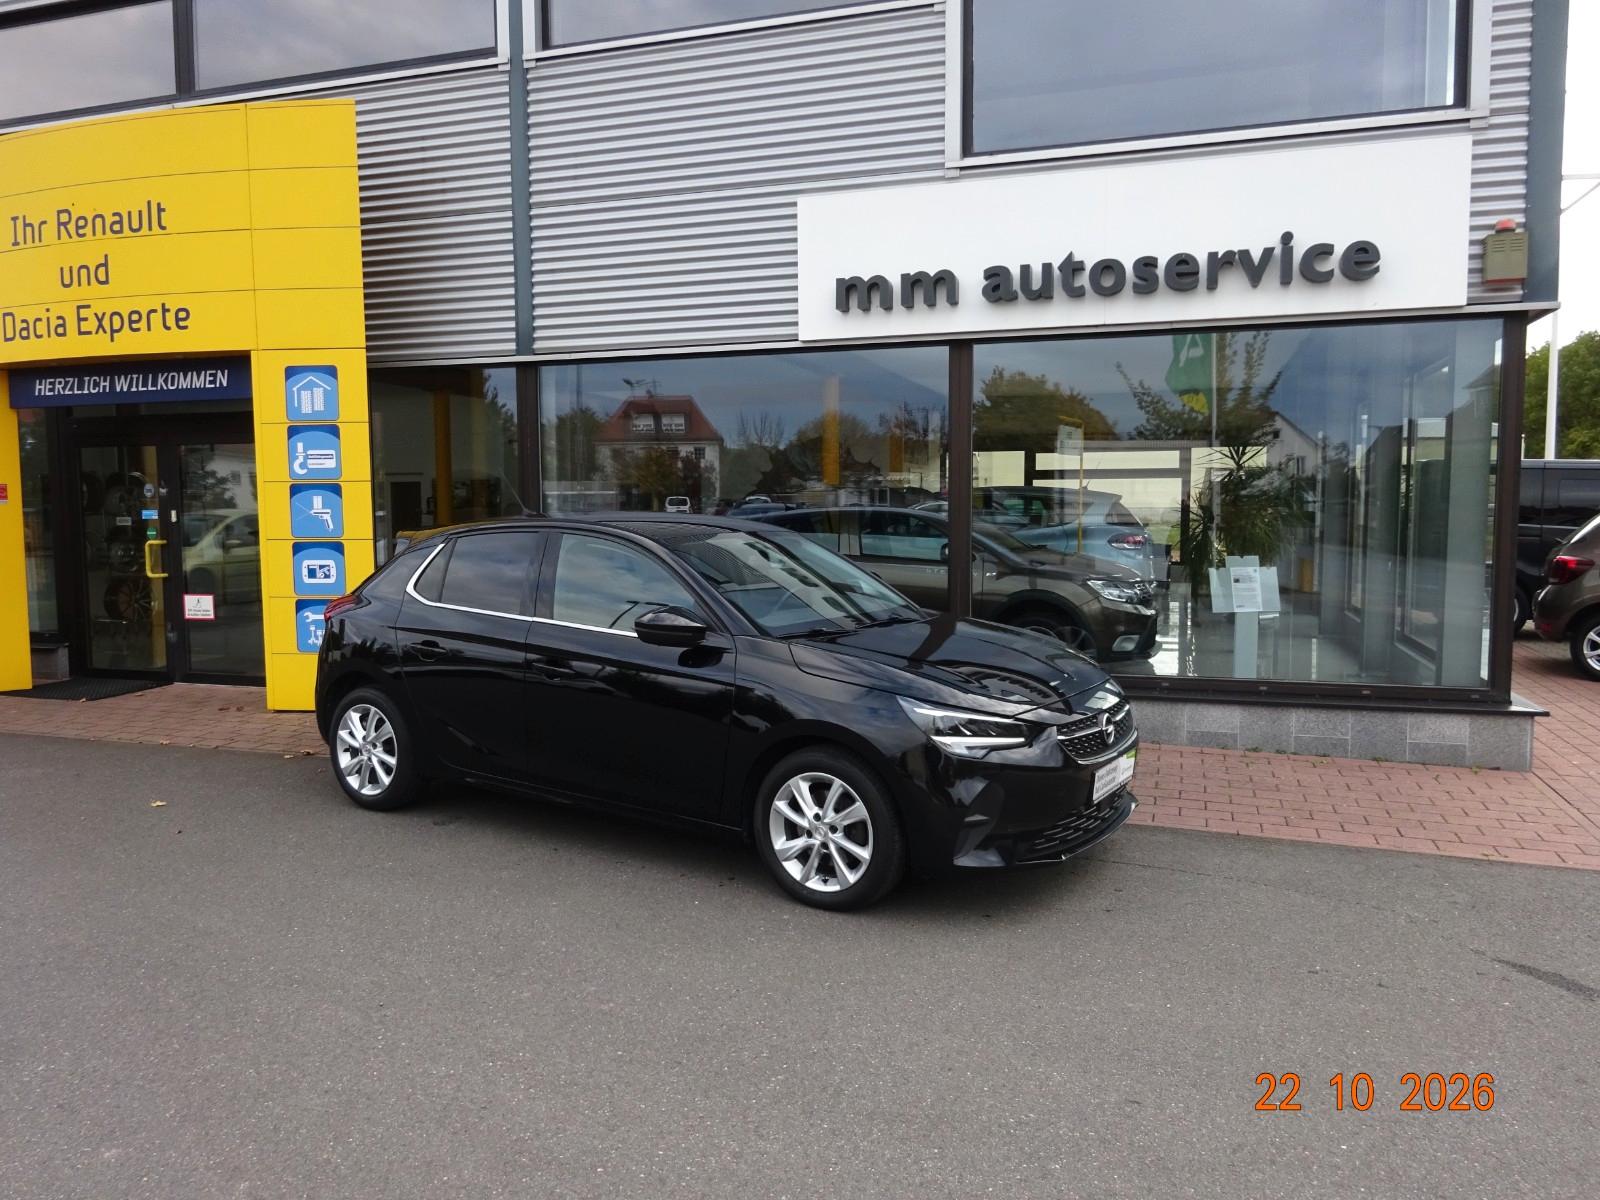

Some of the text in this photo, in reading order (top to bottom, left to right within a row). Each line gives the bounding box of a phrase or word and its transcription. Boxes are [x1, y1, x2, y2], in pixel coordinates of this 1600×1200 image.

[10, 199, 168, 247] Ihr Renault
[60, 253, 110, 289] und
[835, 230, 1382, 314] mm autoservice
[2, 302, 191, 343] Dacia Experte
[34, 368, 229, 396] HERZLICH WILLKOMMEN
